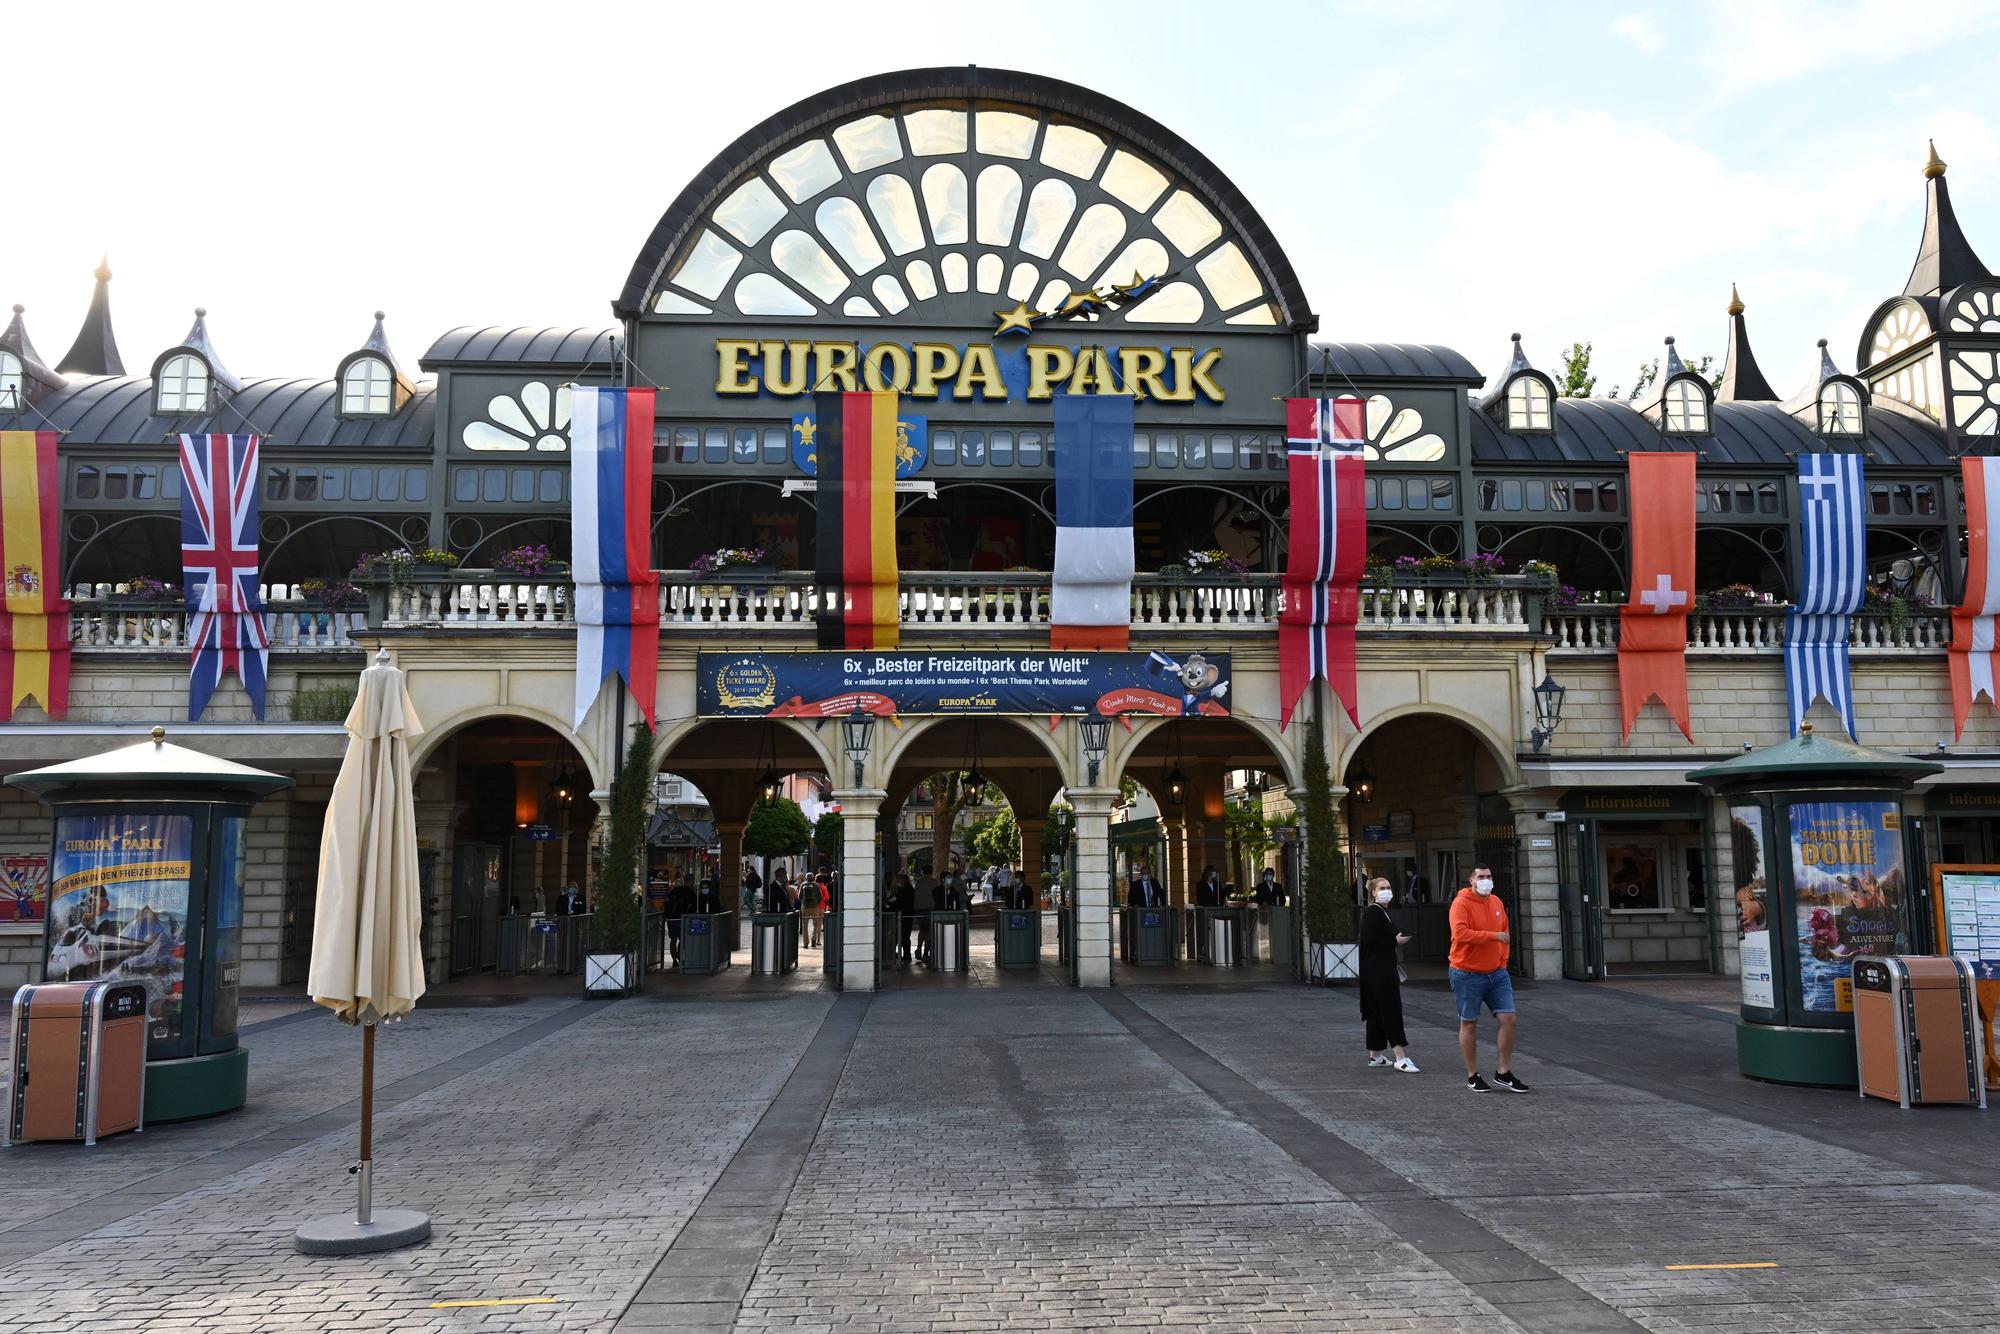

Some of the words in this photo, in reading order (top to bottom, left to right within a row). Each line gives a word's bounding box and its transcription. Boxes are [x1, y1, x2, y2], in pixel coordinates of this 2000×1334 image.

[716, 338, 1007, 401] EUROPA
[1026, 344, 1225, 403] PARK
[843, 657, 863, 673] 6x
[928, 656, 1016, 675] Freizeitpark
[1020, 656, 1045, 672] der
[740, 669, 763, 677] GOLDEN
[844, 678, 853, 686] 6x
[859, 677, 887, 686] meilleur
[888, 678, 903, 687] parc
[904, 677, 914, 685] de
[914, 677, 936, 685] loisirs
[937, 677, 945, 685] du
[947, 677, 970, 685] monde
[979, 677, 989, 685] 6x
[1009, 677, 1033, 686] Theme
[1034, 677, 1051, 686] Park
[938, 698, 971, 706] EUROPA
[975, 698, 997, 706] PARK
[1102, 697, 1124, 709] Danke
[1126, 694, 1145, 704] Merci
[1148, 696, 1166, 709] Thank
[1165, 704, 1177, 713] you
[1584, 795, 1670, 809] Information
[1801, 829, 1874, 841] TRAUMZEIT
[65, 839, 112, 851] EUROPA
[121, 838, 162, 850] PARK
[1801, 841, 1875, 866] DOME
[70, 875, 88, 888] BAHN
[90, 873, 99, 883] IN
[100, 870, 118, 881] DEN
[119, 865, 186, 879] FREIZEITSPASS
[1849, 934, 1895, 943] ADVENTURE
